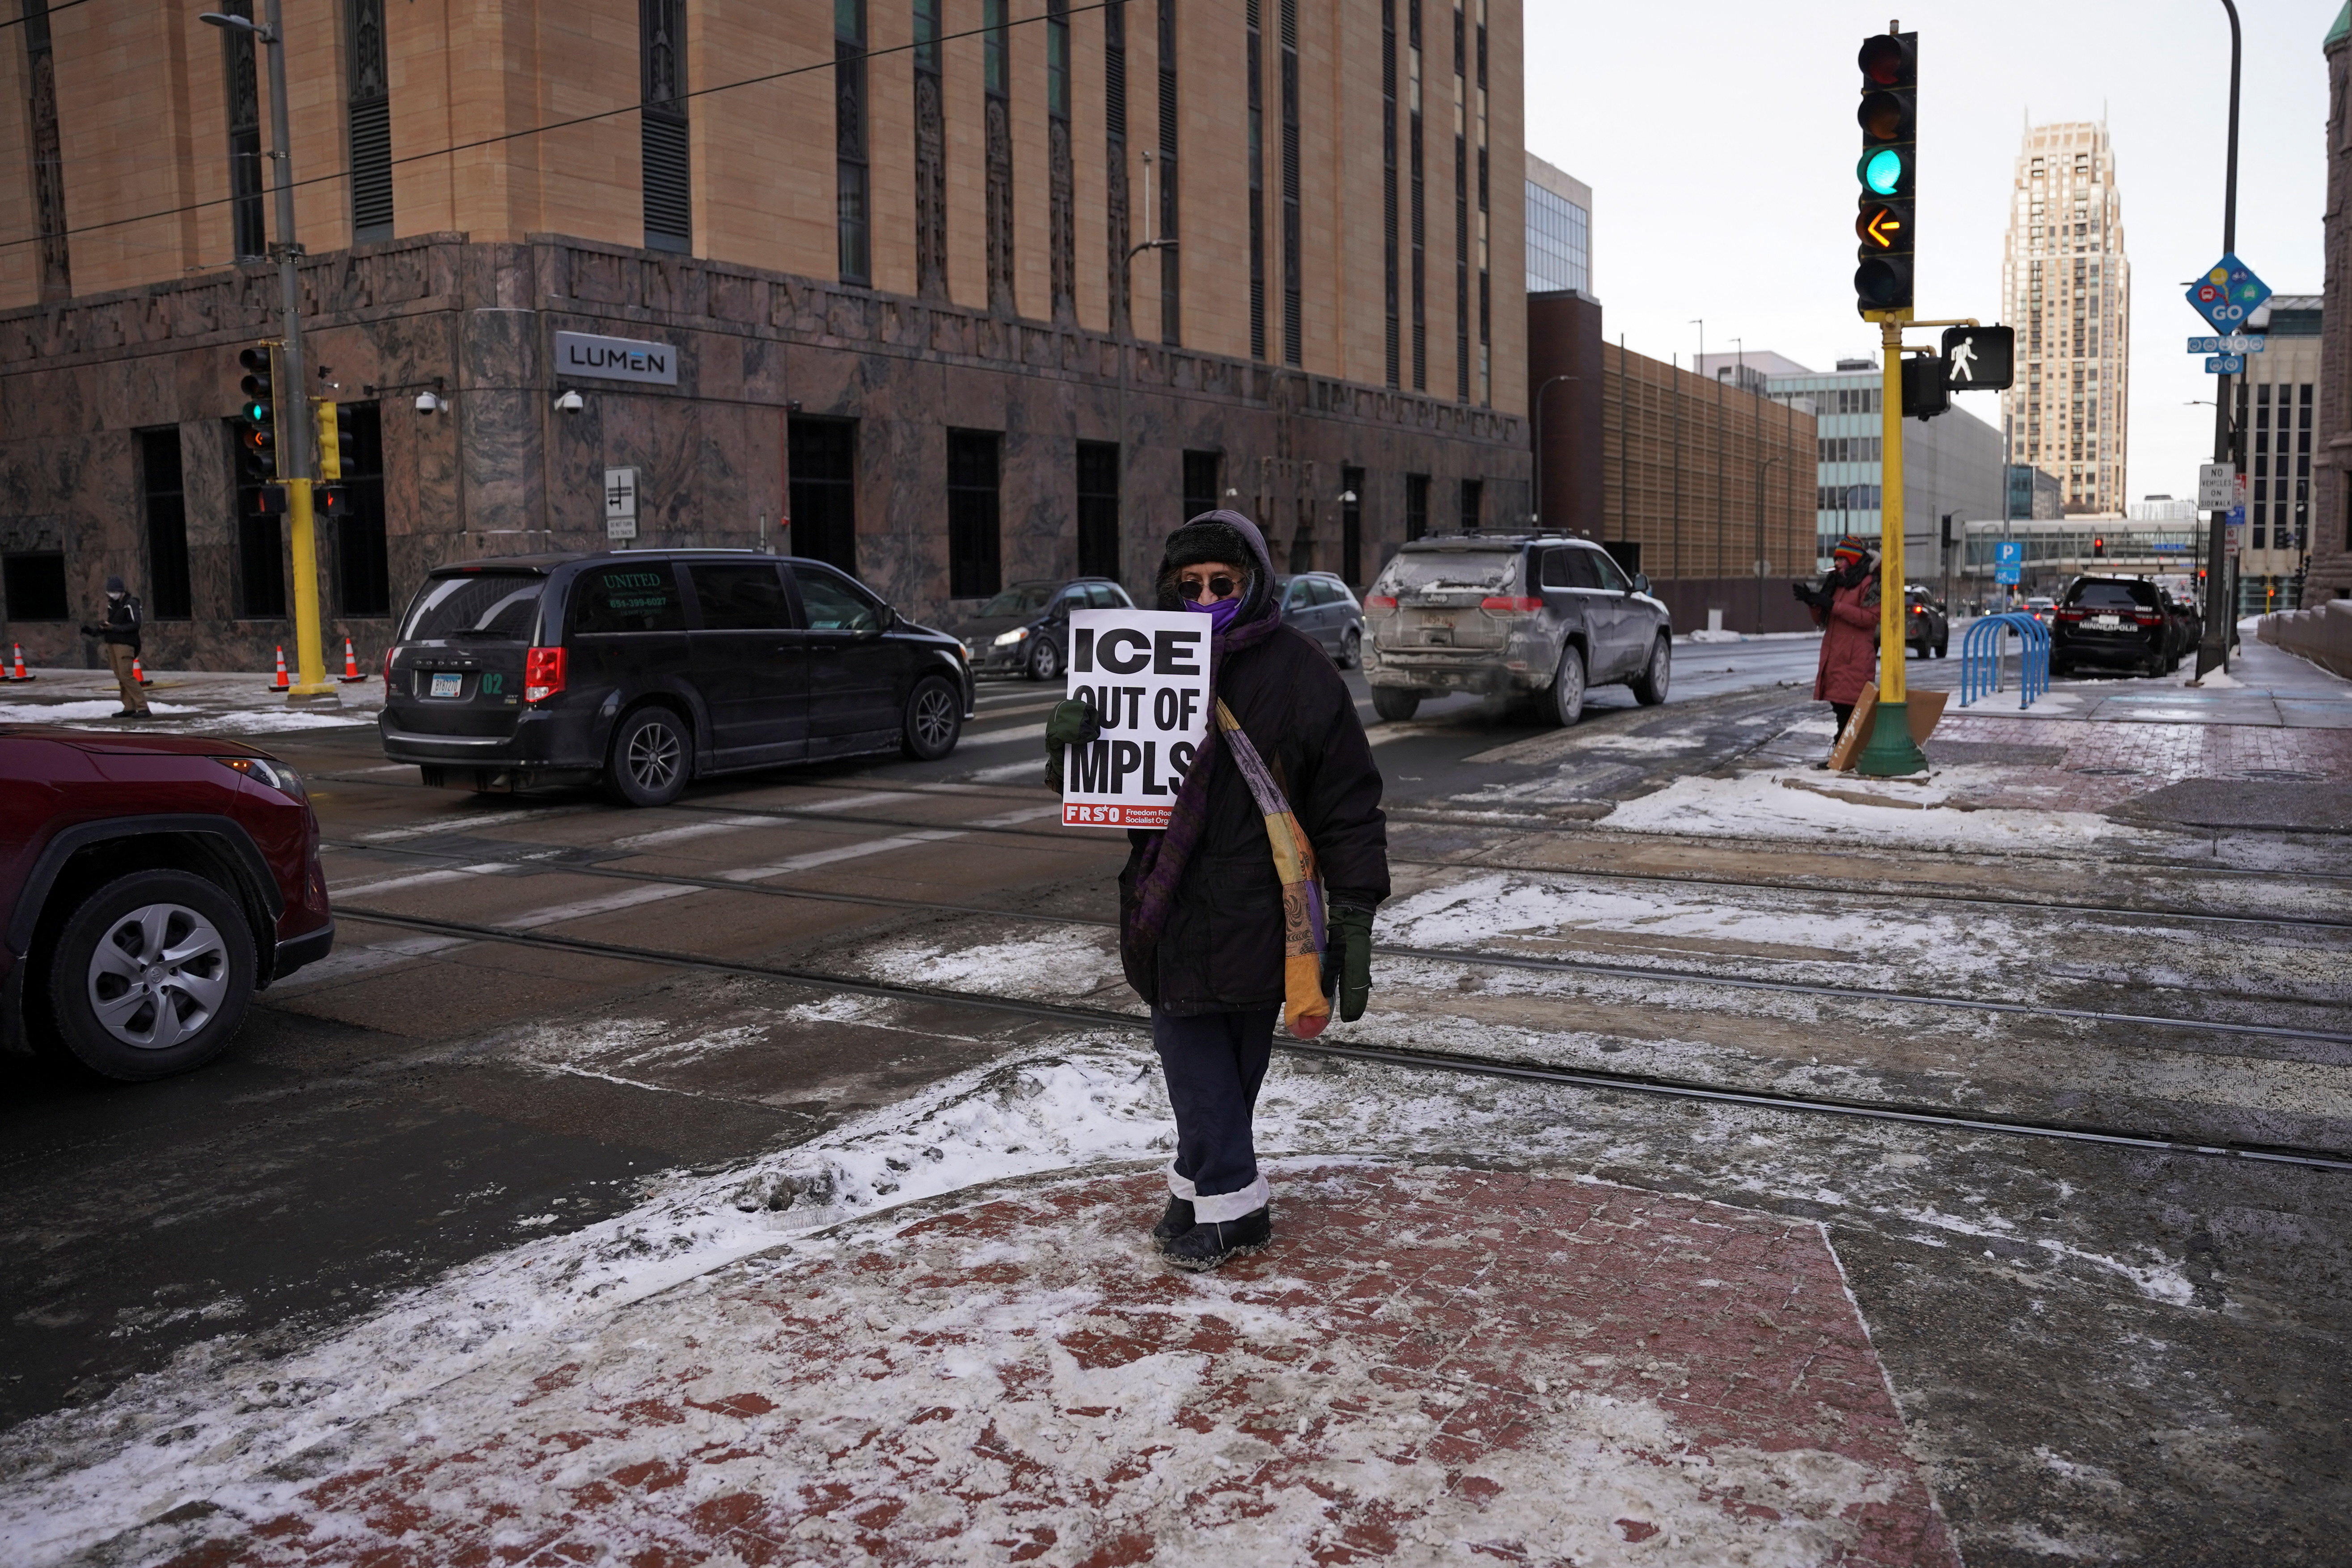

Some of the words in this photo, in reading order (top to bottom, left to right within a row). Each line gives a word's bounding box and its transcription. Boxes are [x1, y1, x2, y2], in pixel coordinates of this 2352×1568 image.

[2212, 304, 2243, 321] GO
[571, 345, 664, 373] LUMEN
[2211, 468, 2223, 477] NO
[2003, 545, 2014, 559] P
[603, 573, 660, 588] UNITED
[2079, 621, 2139, 633] MINNEAPOLIS
[1074, 628, 1201, 676] ICE
[483, 673, 503, 694] 02
[1154, 687, 1200, 731] OF
[1070, 740, 1197, 795] MPLS
[1066, 805, 1120, 823] FRSO
